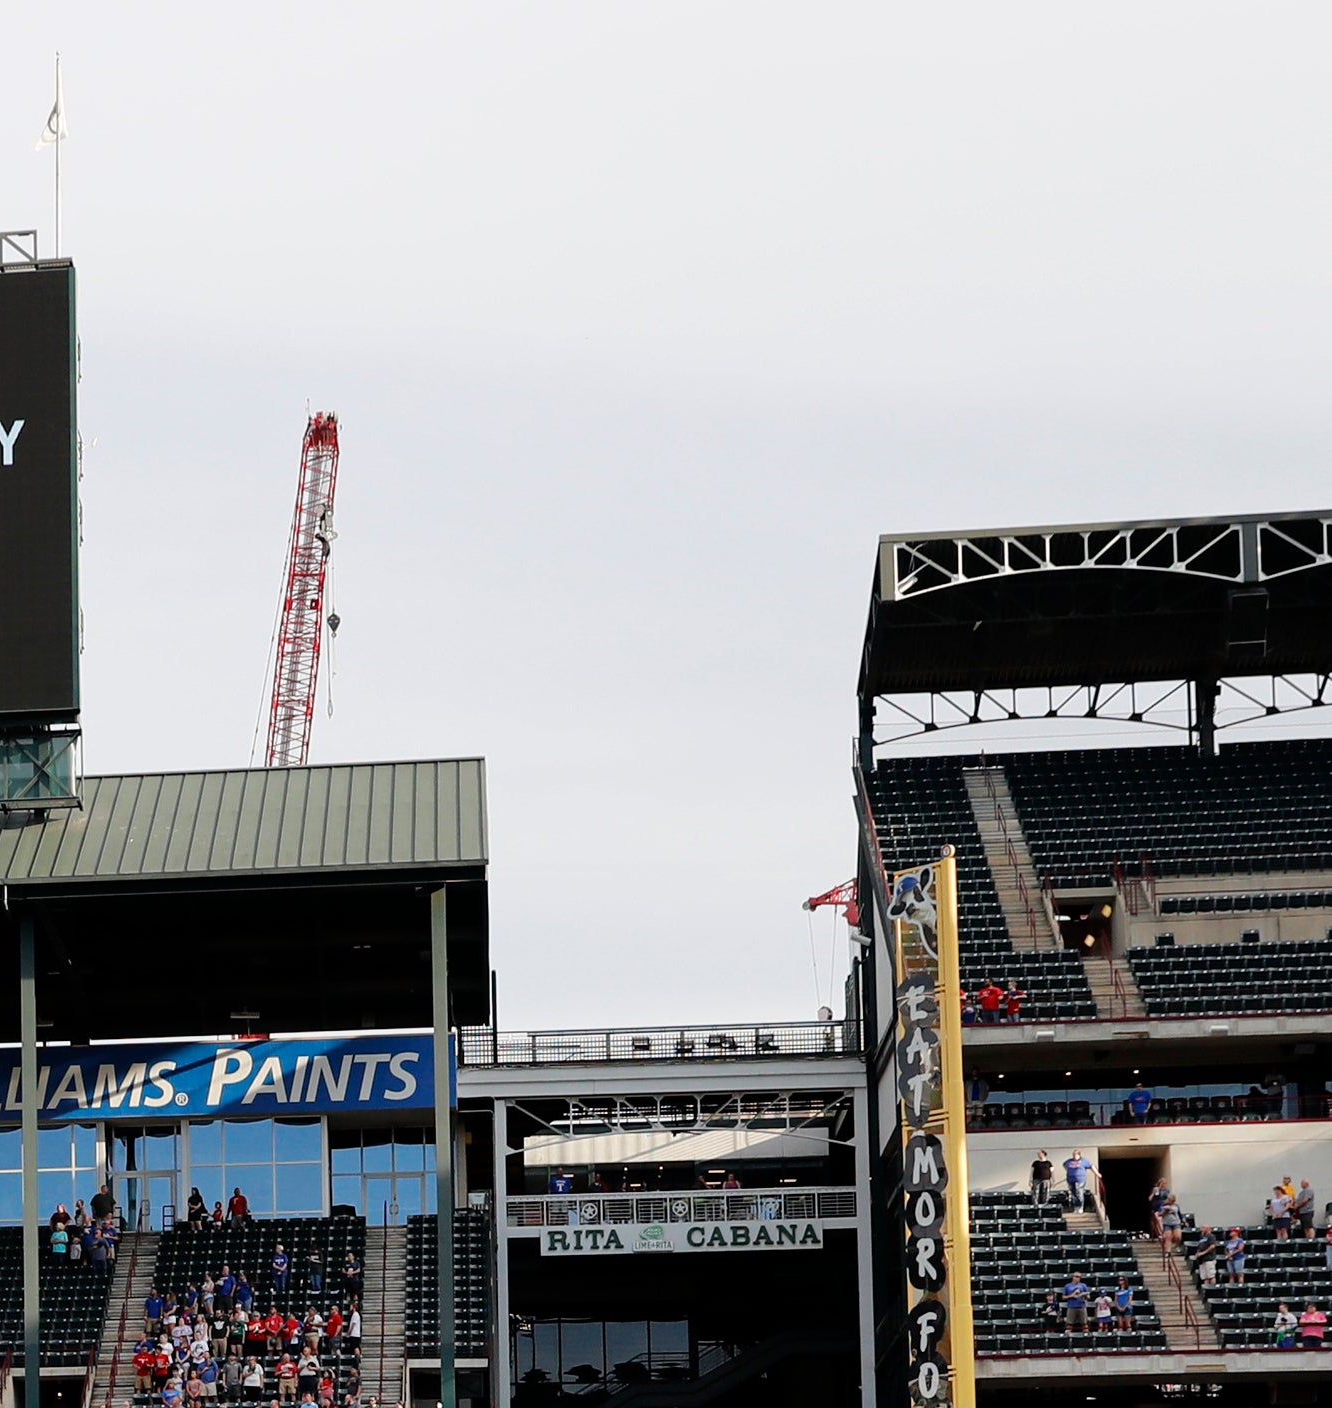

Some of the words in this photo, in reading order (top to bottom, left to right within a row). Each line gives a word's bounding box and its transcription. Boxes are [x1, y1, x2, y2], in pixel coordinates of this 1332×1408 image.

[207, 1047, 421, 1106] PAINTS
[547, 1229, 624, 1252] RITA
[686, 1223, 822, 1248] CABANA
